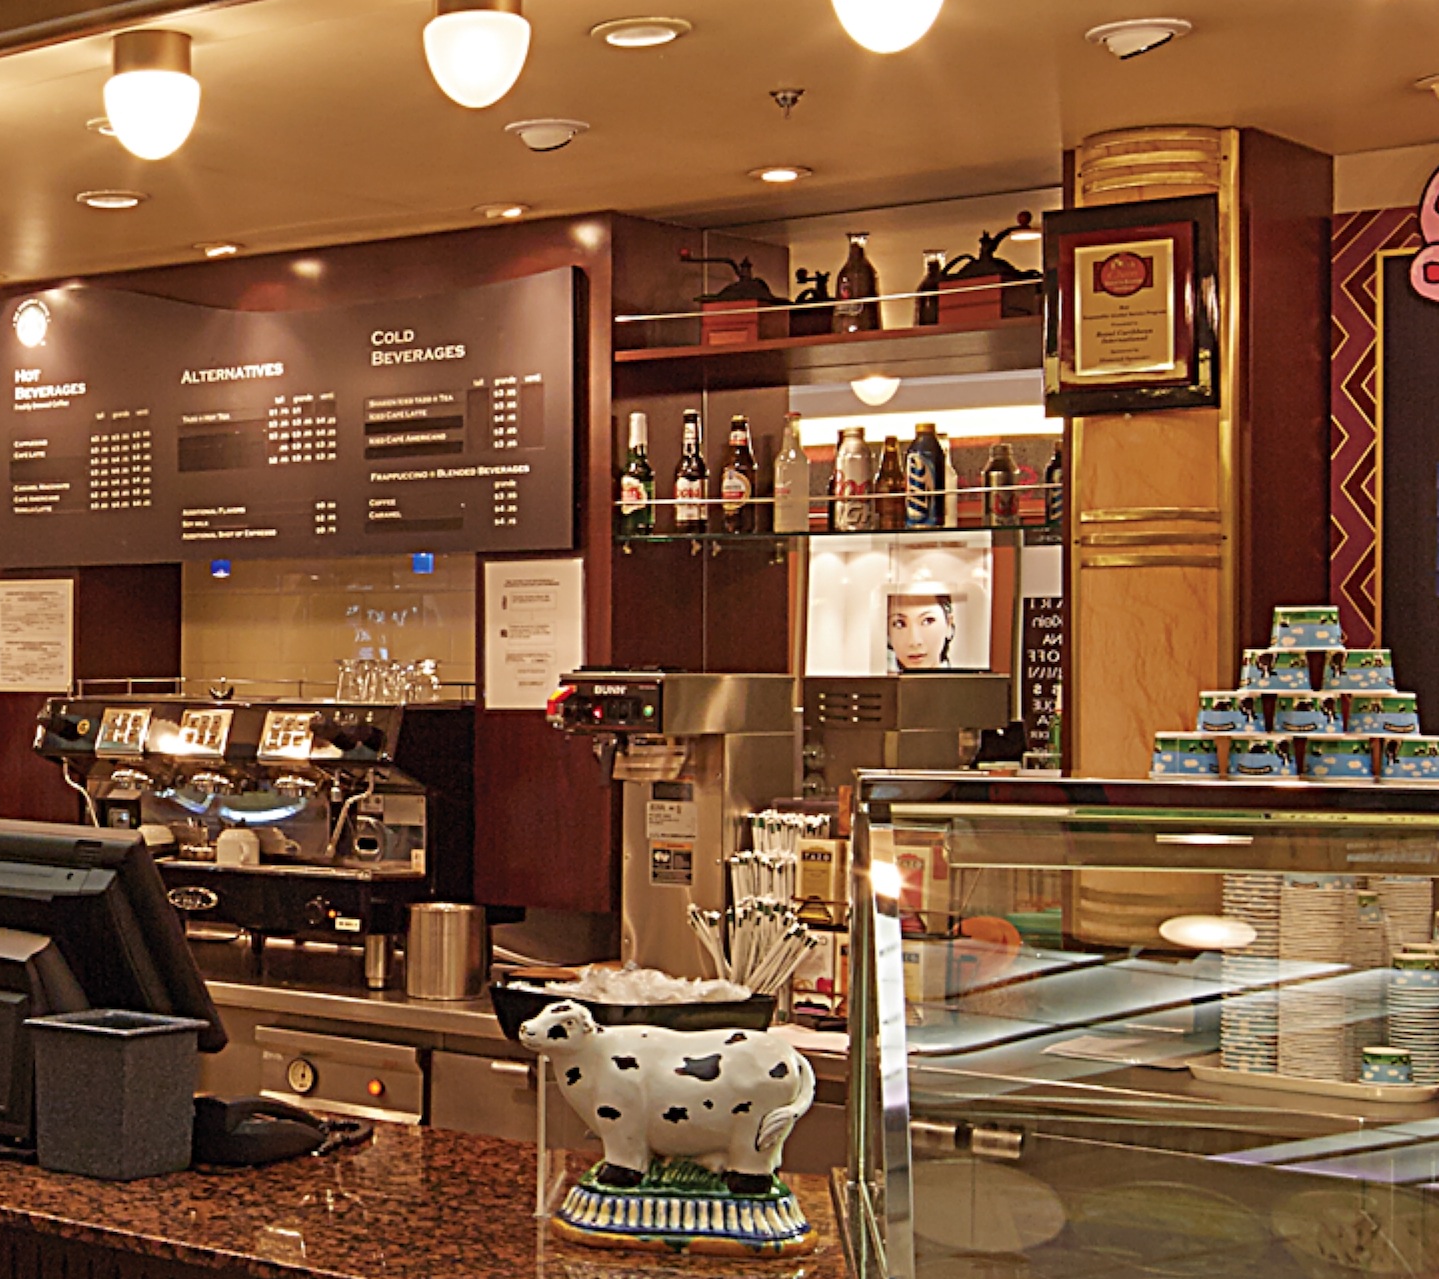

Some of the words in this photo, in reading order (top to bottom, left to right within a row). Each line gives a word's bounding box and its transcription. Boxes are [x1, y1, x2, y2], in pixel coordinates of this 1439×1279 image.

[371, 329, 414, 346] COLD
[371, 344, 466, 366] BEVERAGES
[14, 369, 41, 383] HOT
[181, 362, 284, 384] ALTERNATIVES
[14, 383, 86, 400] BEVERAGES
[594, 684, 627, 695] BUNN
